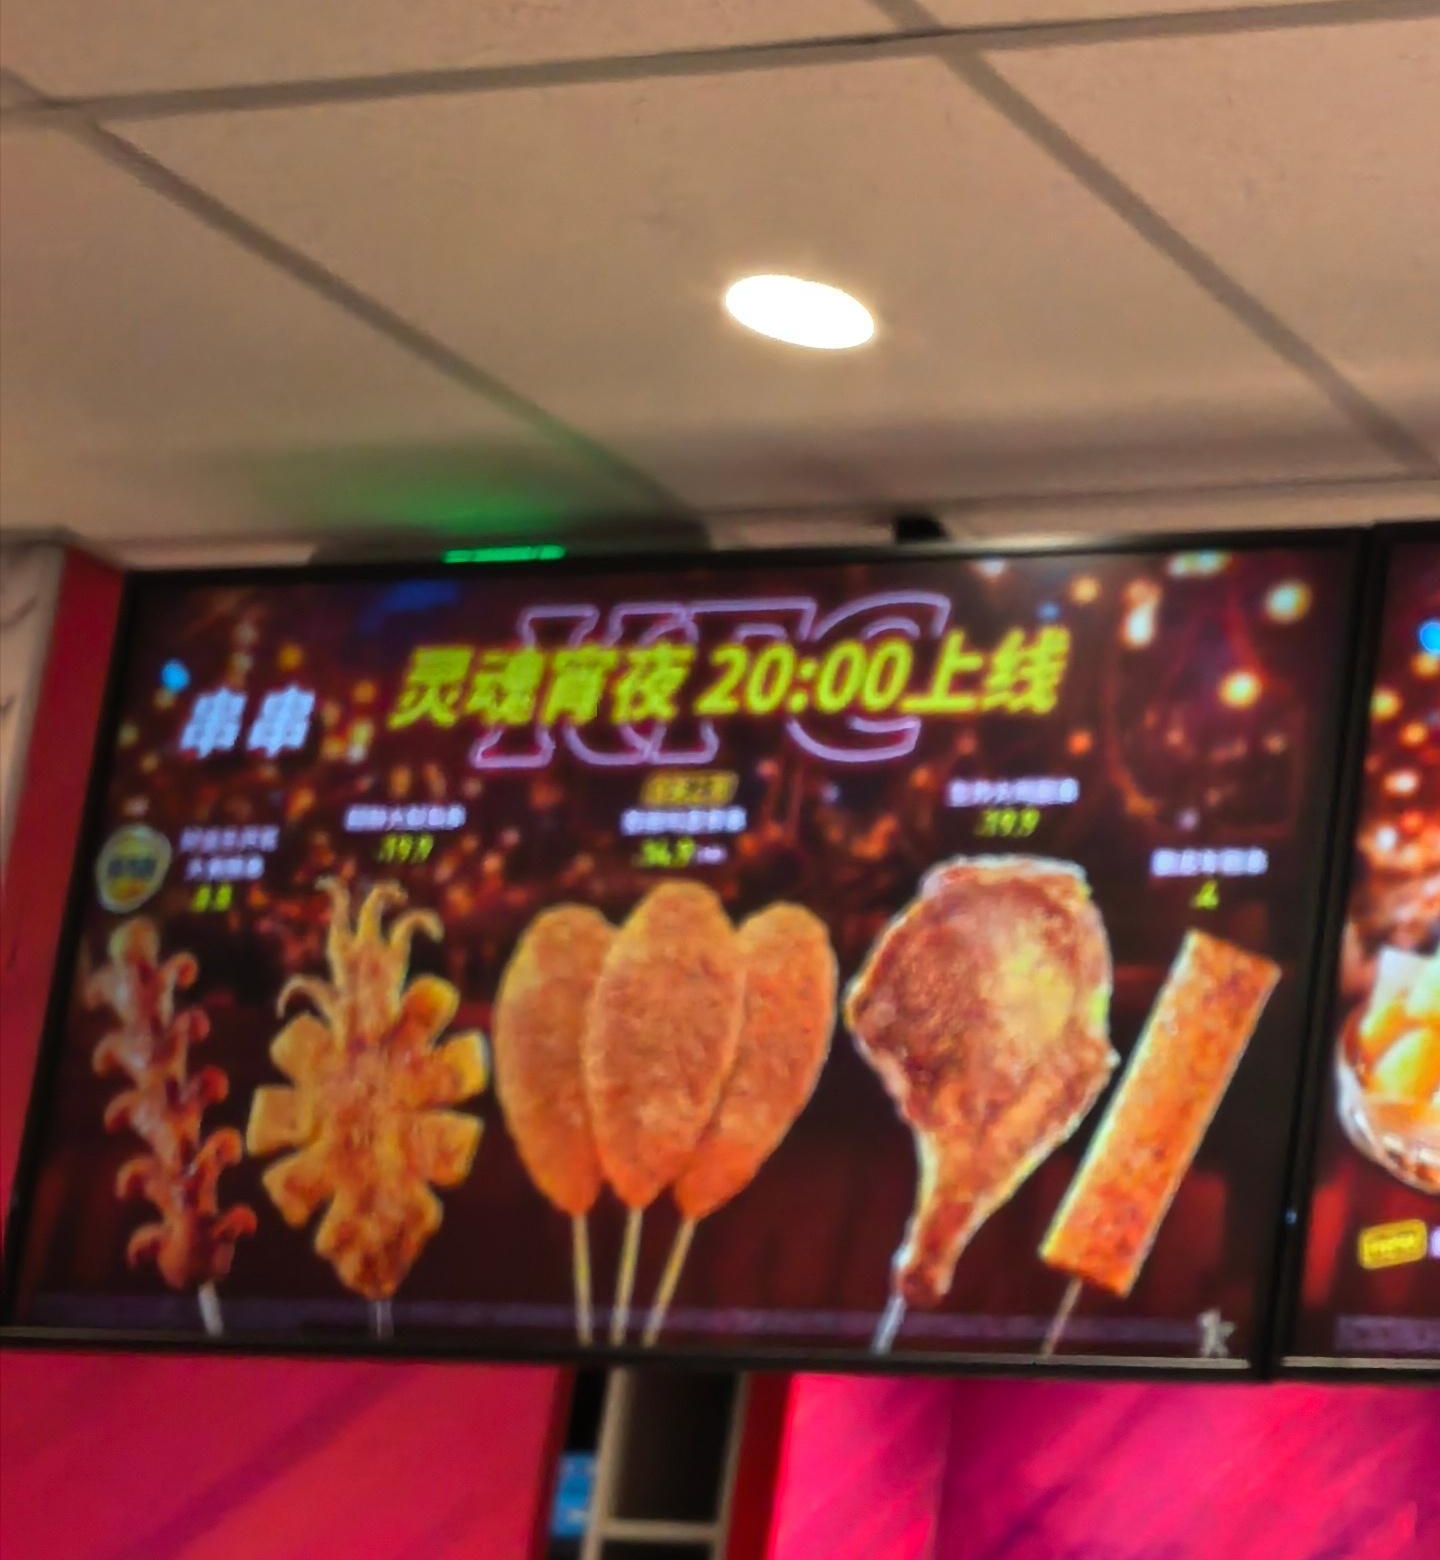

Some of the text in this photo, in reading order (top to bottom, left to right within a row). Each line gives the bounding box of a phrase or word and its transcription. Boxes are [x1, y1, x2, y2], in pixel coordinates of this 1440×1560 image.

[180, 686, 316, 758] 串串
[387, 627, 1070, 730] 灵魂宵夜 20:00上线
